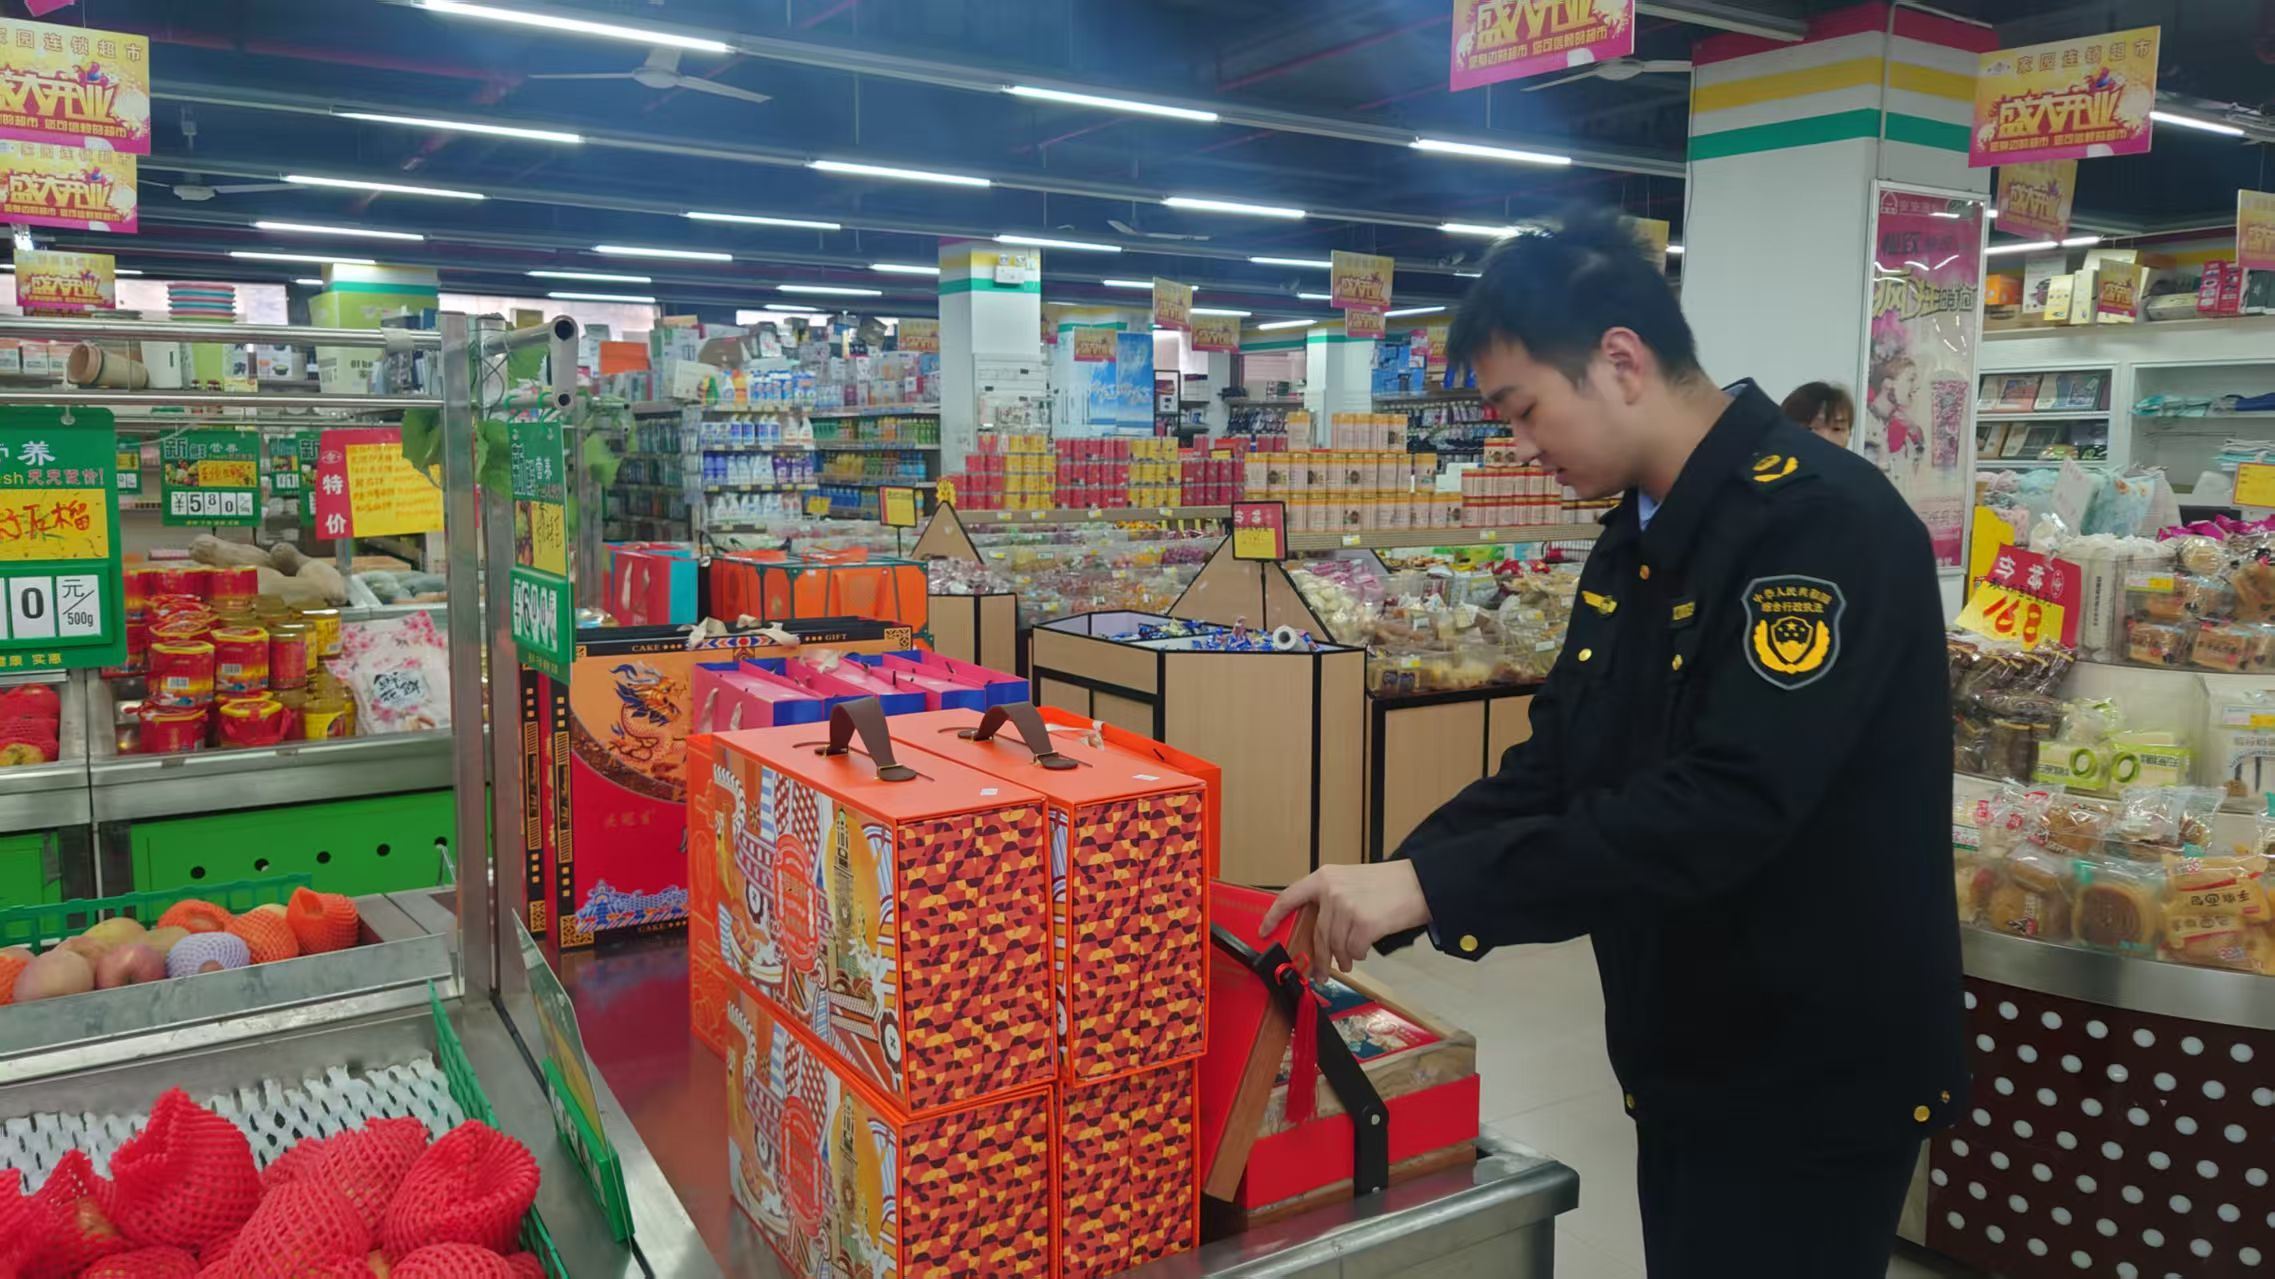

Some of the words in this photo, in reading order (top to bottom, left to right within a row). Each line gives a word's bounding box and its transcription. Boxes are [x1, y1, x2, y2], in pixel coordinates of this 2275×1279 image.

[2016, 39, 2152, 74] 家园连锁超市
[0, 114, 38, 127] 的超市
[1999, 91, 2122, 138] 盛大开业
[9, 173, 112, 212] 盛大开业
[21, 587, 44, 619] 0
[632, 644, 662, 653] CAKE
[825, 633, 848, 642] GIFT
